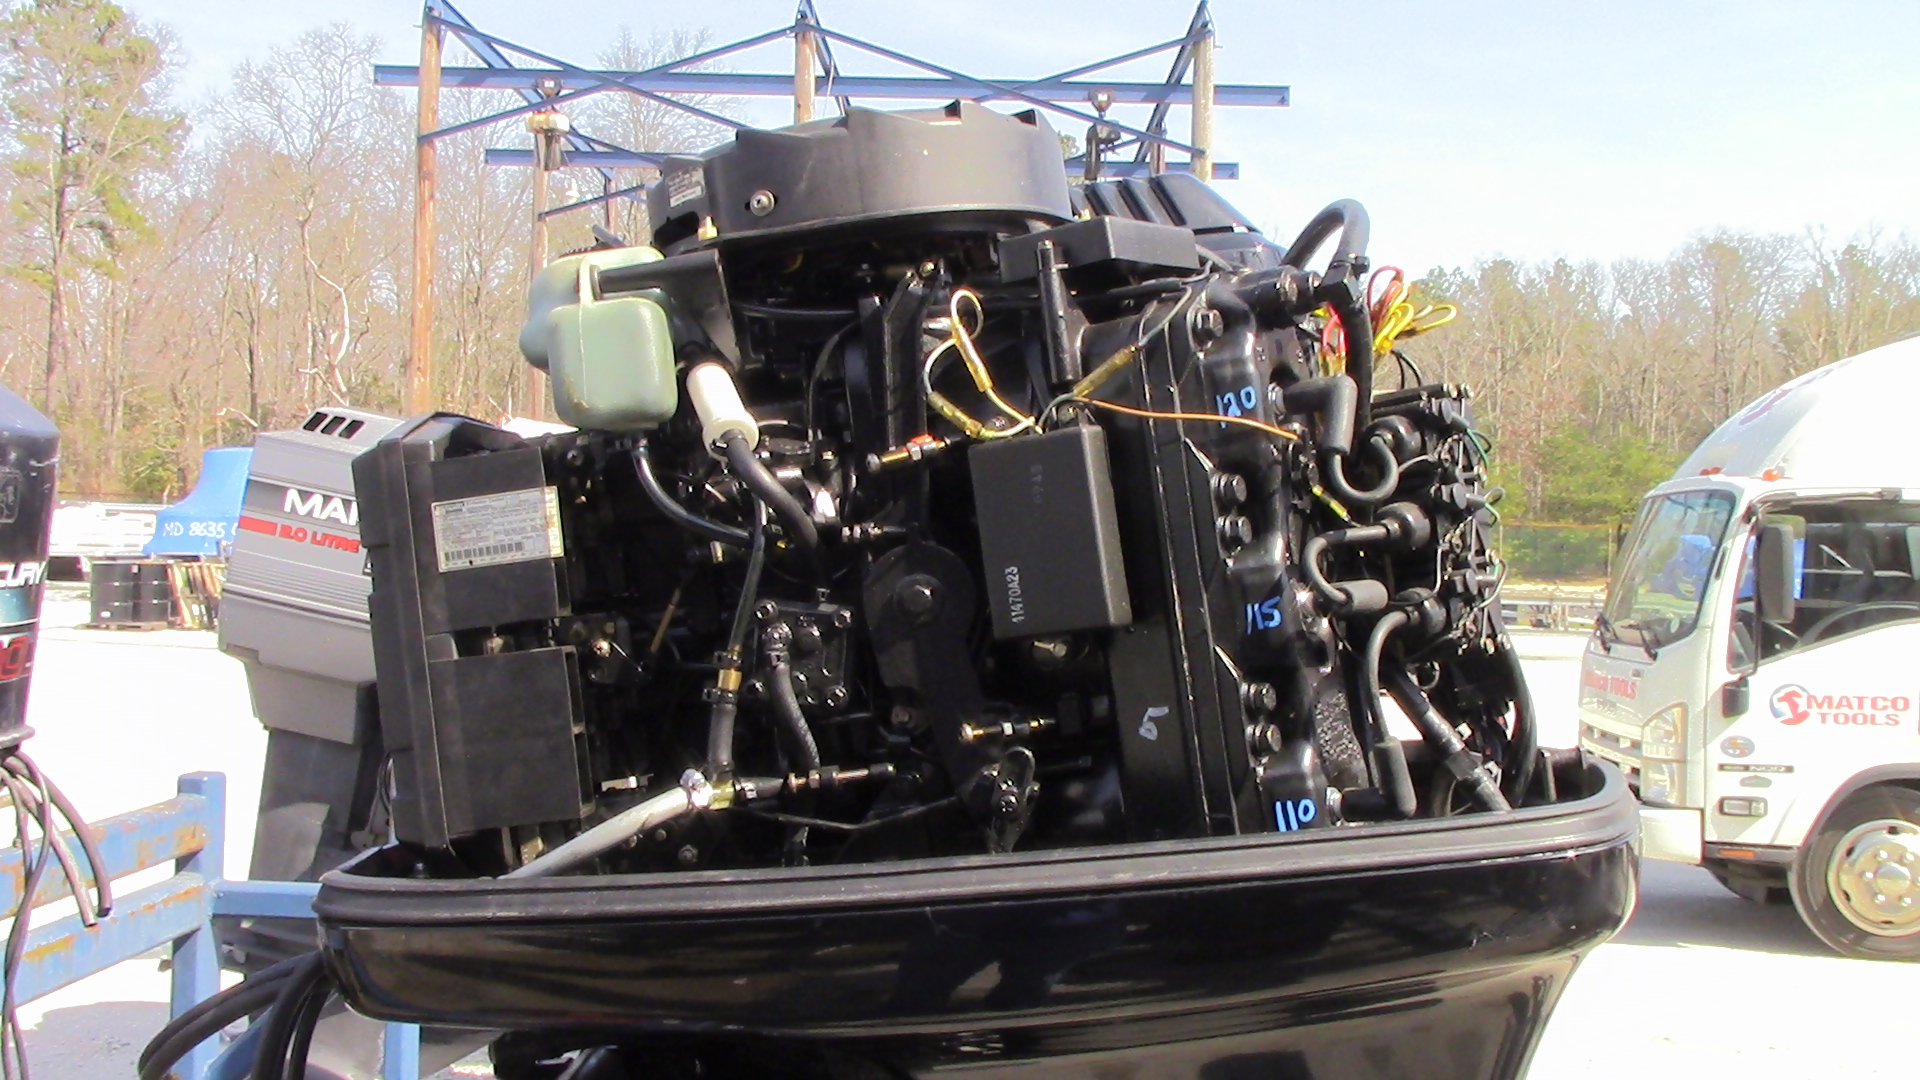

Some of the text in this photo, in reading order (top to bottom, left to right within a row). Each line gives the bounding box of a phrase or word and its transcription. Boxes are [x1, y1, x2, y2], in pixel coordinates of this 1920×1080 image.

[1216, 385, 1257, 429] 120
[163, 521, 184, 537] MD
[188, 521, 227, 539] 8635
[1246, 596, 1283, 634] 115
[1806, 694, 1910, 712] MATCO
[1817, 712, 1900, 726] TOOLS
[1275, 798, 1316, 833] 110
